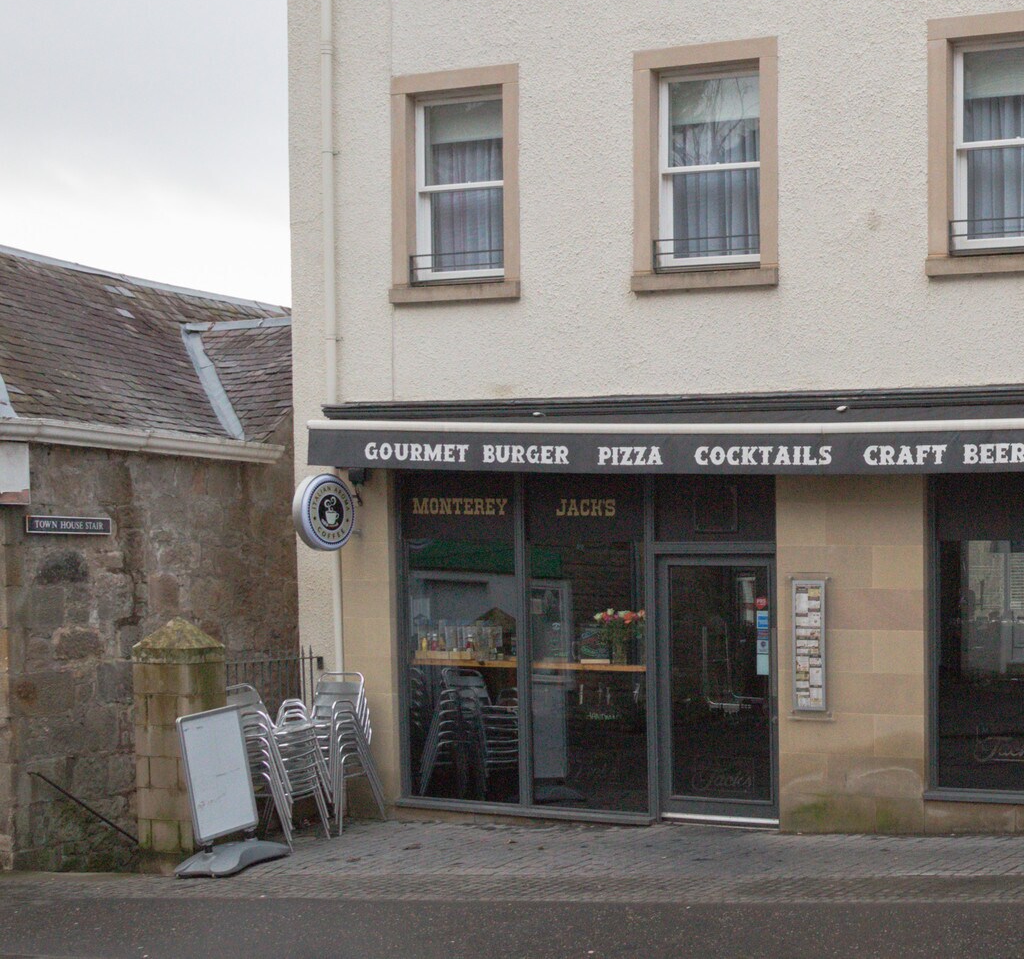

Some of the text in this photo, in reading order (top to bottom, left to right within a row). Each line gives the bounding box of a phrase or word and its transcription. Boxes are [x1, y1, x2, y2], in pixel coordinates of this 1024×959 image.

[364, 442, 469, 463] GOURMET
[483, 444, 569, 465] BURGER
[597, 445, 664, 466] PIZZA
[694, 445, 832, 466] COCKTAILS
[863, 443, 948, 466] CRAFT
[312, 485, 350, 511] ITALIAN AROMA
[412, 497, 508, 516] MONTEREY
[34, 520, 104, 530] TOWN HOUSE STAIR
[317, 526, 345, 539] COFFEE
